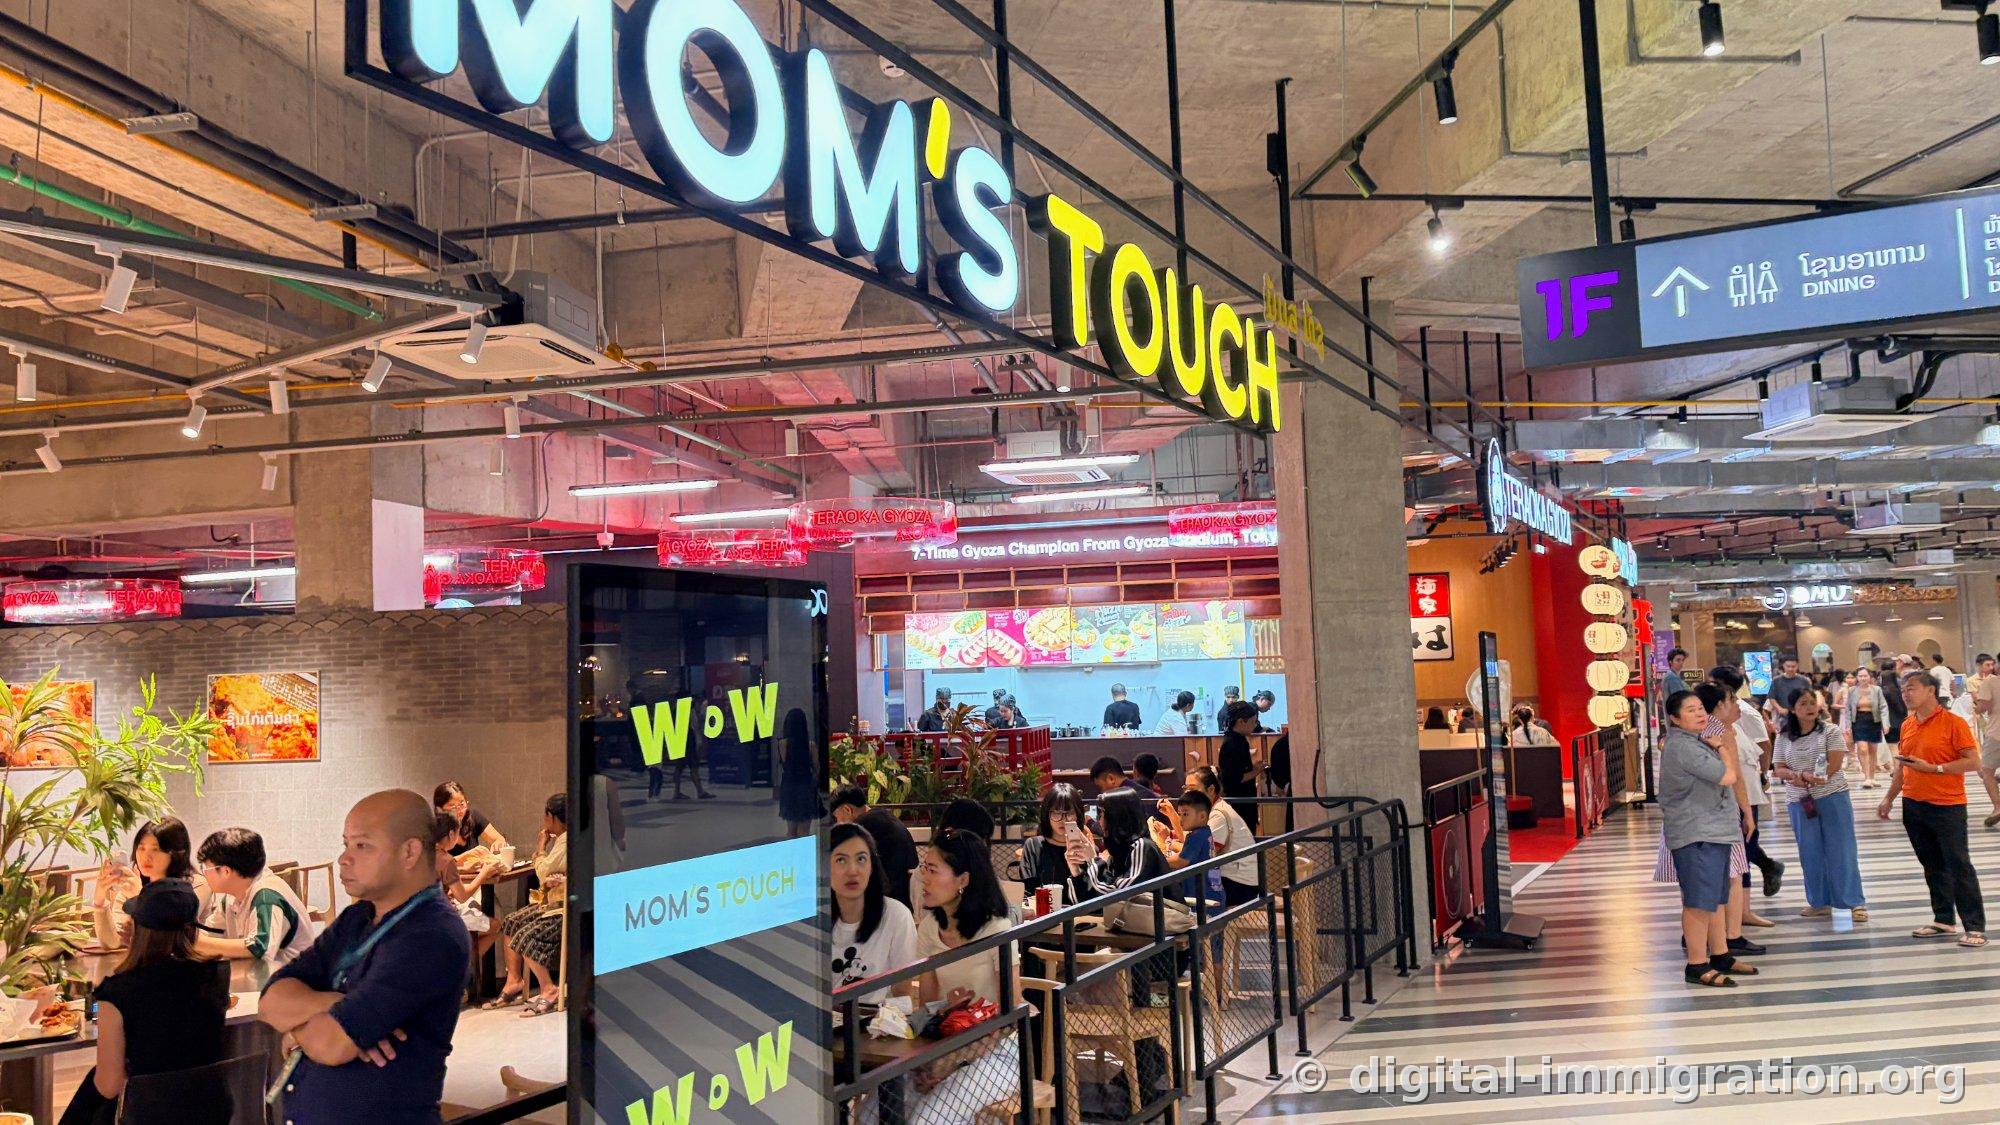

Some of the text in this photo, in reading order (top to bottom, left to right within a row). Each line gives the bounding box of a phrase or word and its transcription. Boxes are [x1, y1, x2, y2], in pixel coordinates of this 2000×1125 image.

[1536, 271, 1619, 341] 1F
[1802, 275, 1876, 297] DINING
[1047, 193, 1281, 432] TOUCH
[812, 508, 932, 525] TERAOKA GYOZA
[961, 544, 1005, 560] Gyoza
[1009, 539, 1082, 558] Champion
[1083, 537, 1120, 551] From
[1123, 535, 1169, 552] Gyoza
[625, 867, 795, 932] MOM'S TOUCH
